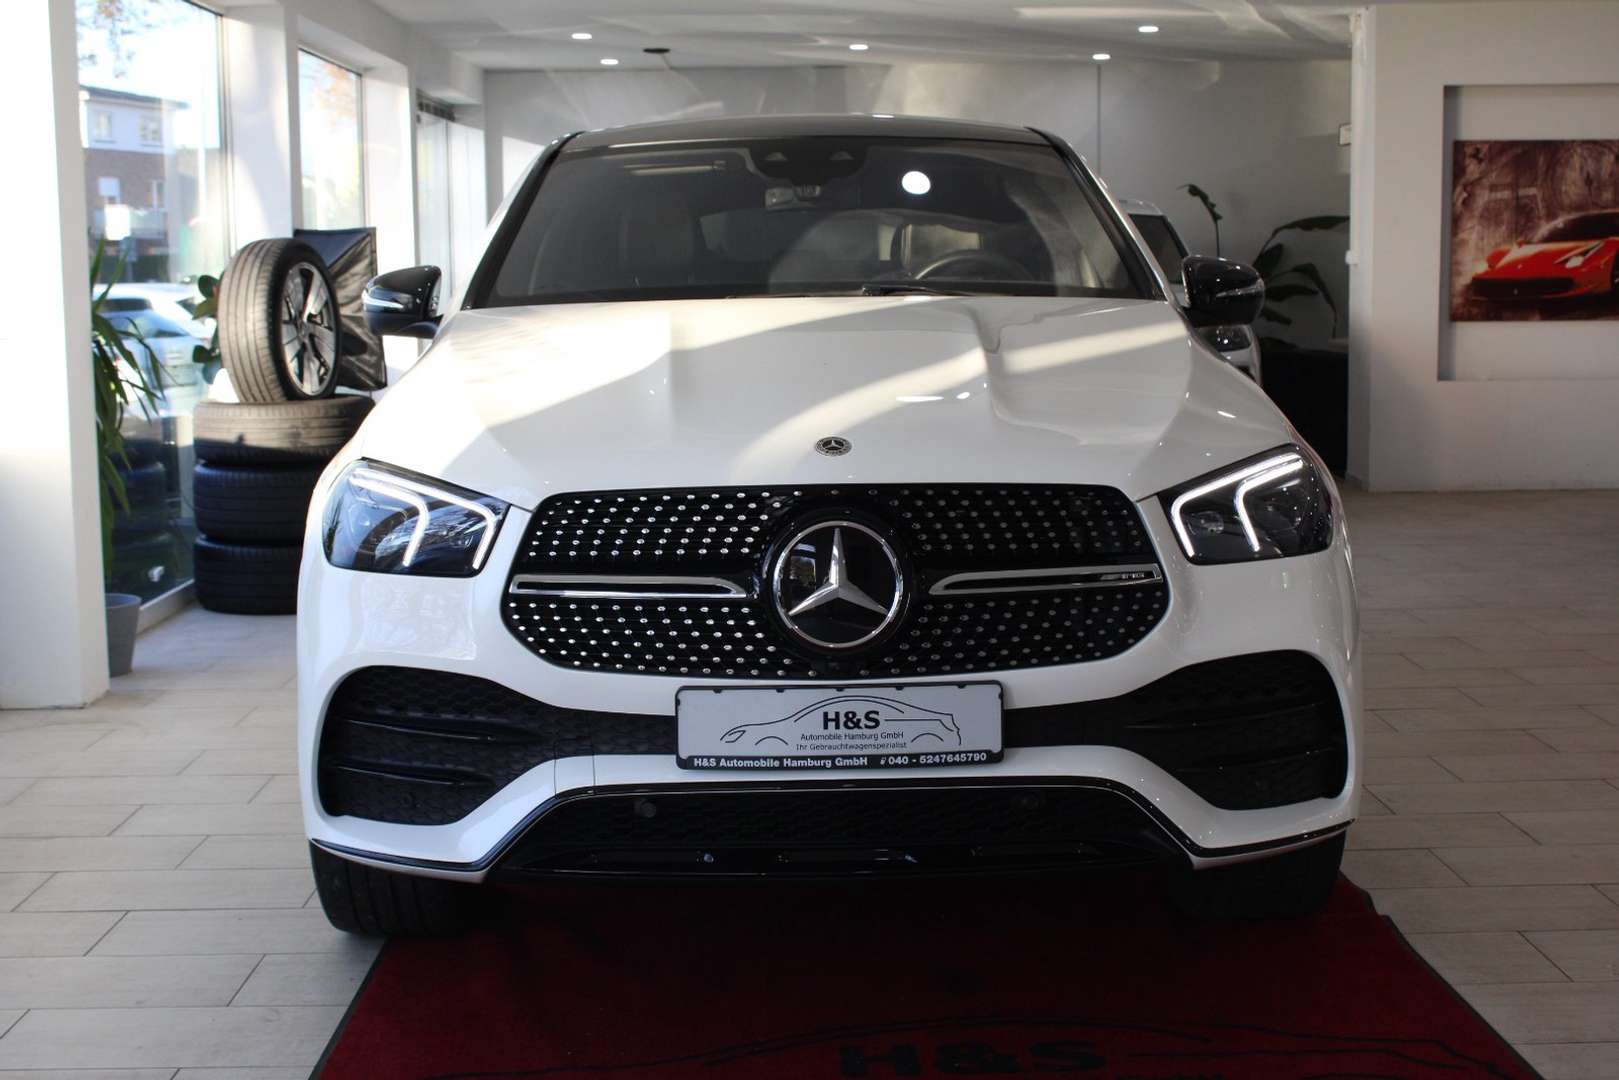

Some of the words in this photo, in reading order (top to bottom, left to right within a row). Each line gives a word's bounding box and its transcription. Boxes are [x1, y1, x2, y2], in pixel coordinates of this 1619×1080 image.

[823, 710, 880, 730] H&S
[800, 733, 843, 741] Automobile
[844, 732, 879, 741] Hamburg
[880, 731, 904, 739] GmbH
[809, 741, 907, 751] Gebrauchtwagenspezialist
[694, 757, 717, 767] H&S
[720, 757, 780, 767] Automobile
[783, 757, 832, 768] Hamburg
[835, 756, 868, 766] GmbH
[888, 755, 909, 765] 040
[919, 752, 987, 764] 5247645790
[840, 1042, 1106, 1076] H&S
